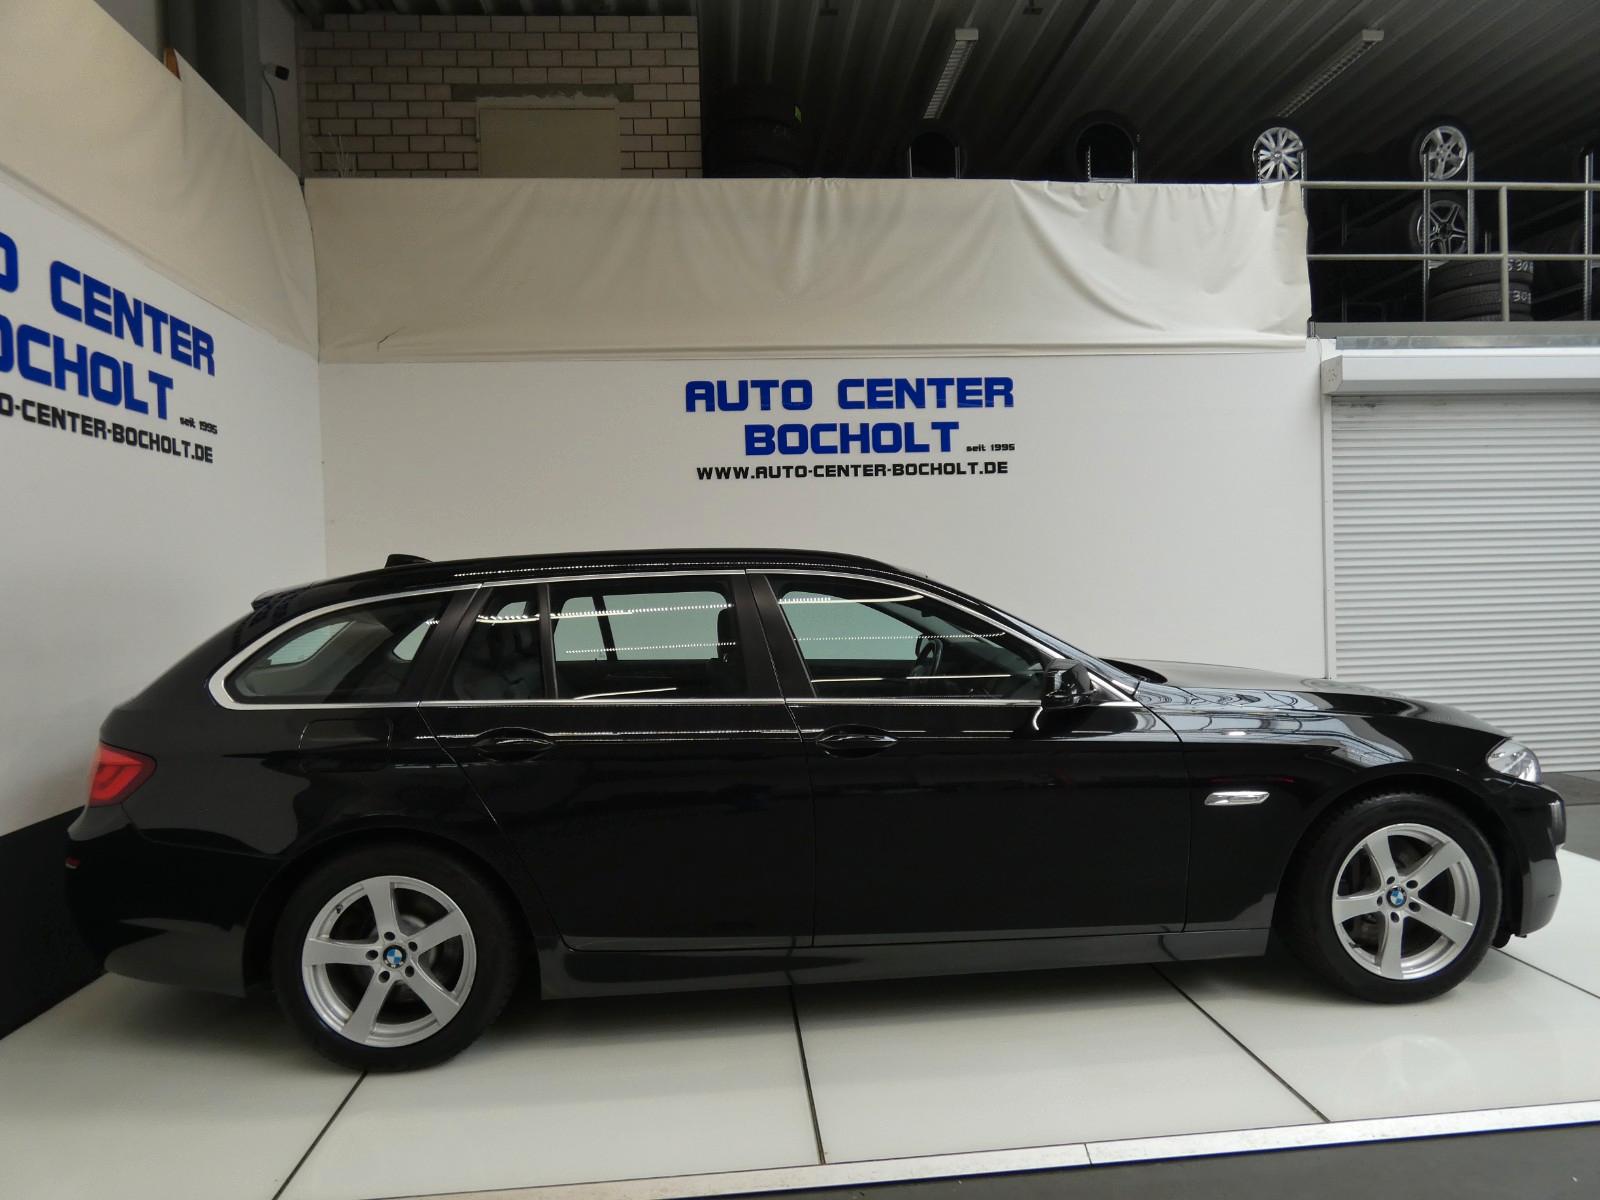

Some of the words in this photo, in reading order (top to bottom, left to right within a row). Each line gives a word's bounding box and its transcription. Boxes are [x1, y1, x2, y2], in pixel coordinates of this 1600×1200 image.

[50, 260, 215, 377] CENTER
[685, 379, 813, 413] AUTO
[837, 376, 1015, 410] CENTER
[179, 416, 196, 429] seit
[199, 420, 218, 435] 1995
[744, 421, 960, 456] BOCHOLT
[966, 443, 987, 453] seit
[990, 443, 1016, 452] 1995
[696, 461, 1009, 481] WWW.AUTO-CENTER-BOCHOLT.DE
